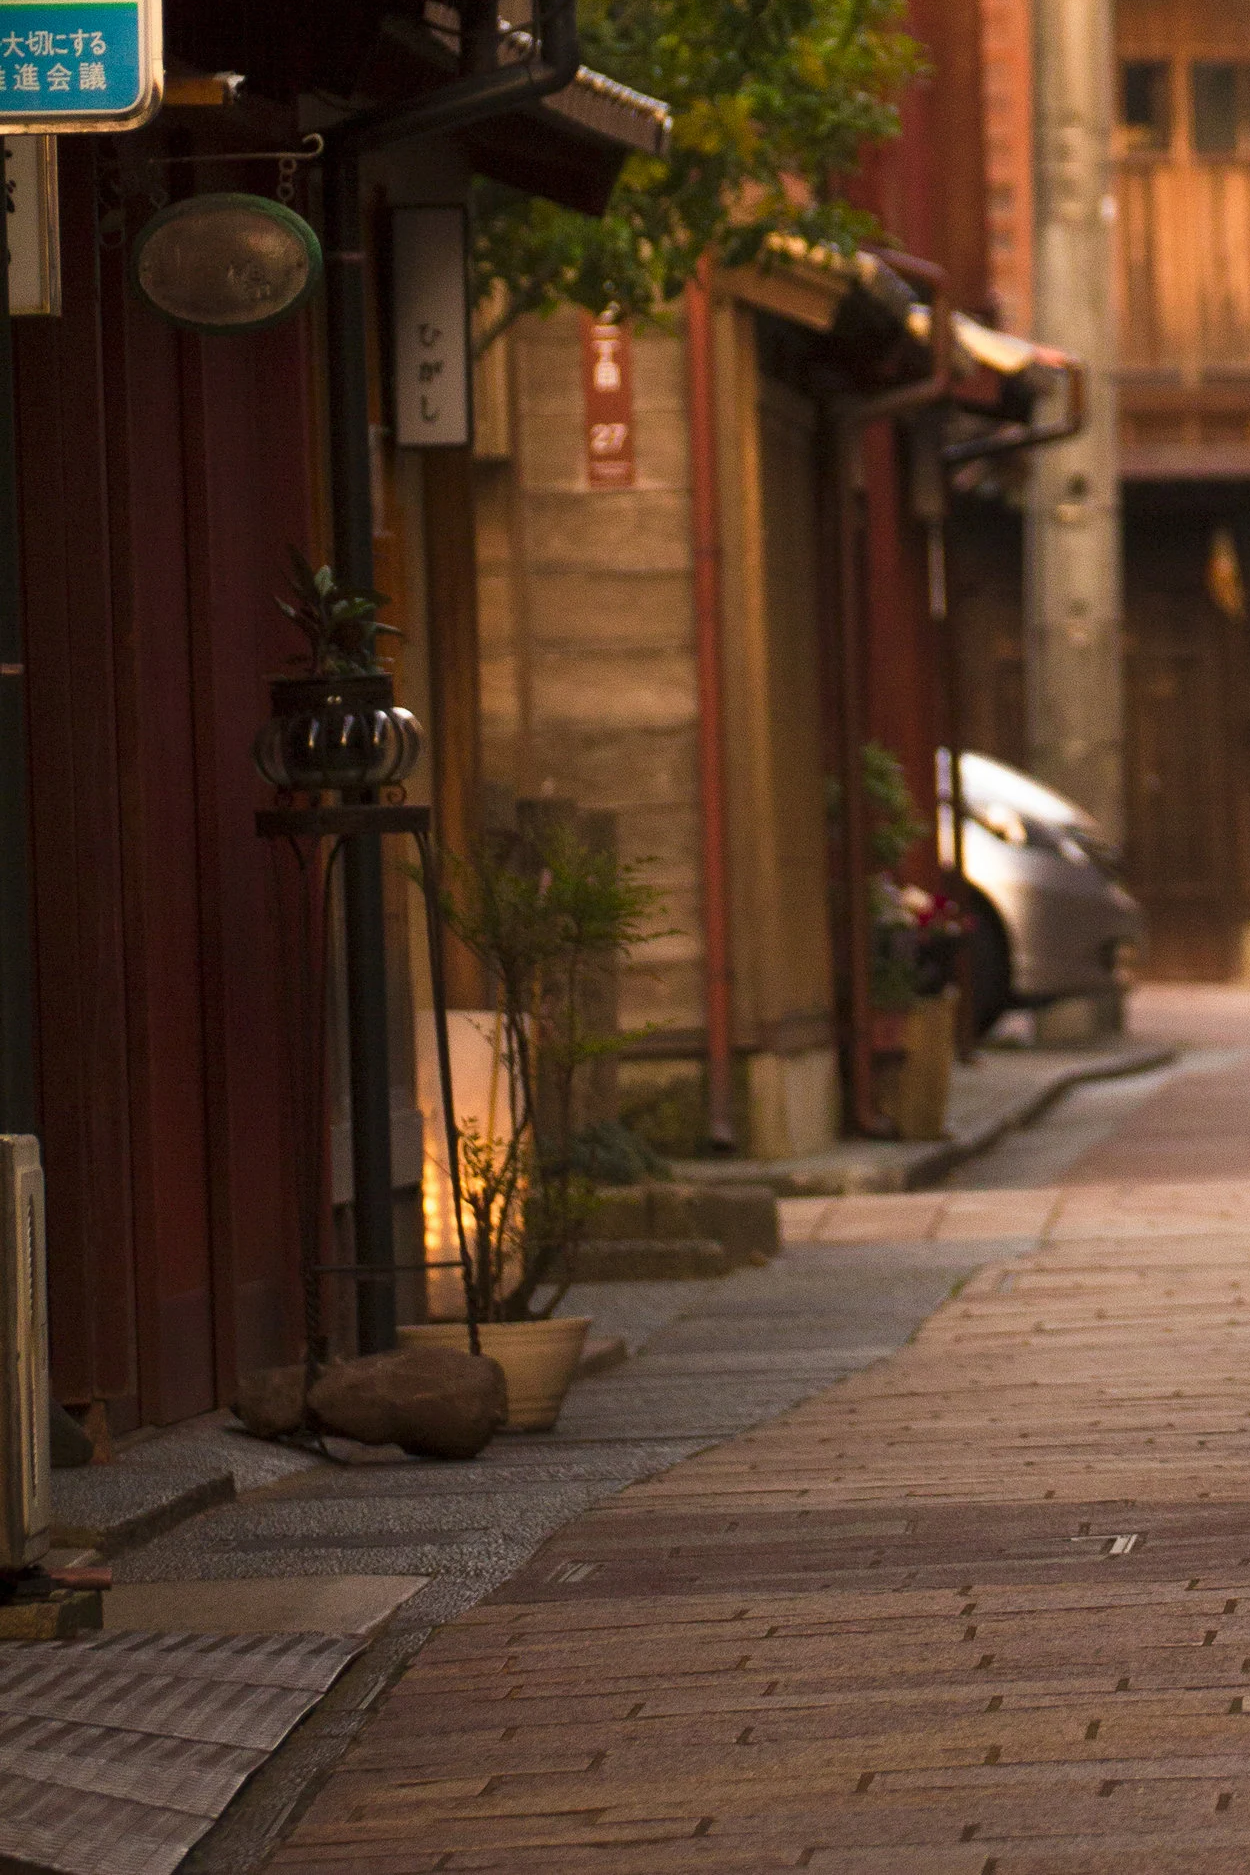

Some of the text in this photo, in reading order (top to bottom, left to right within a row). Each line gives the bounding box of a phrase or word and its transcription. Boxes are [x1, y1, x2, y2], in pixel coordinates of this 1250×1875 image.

[0, 28, 107, 57] 大切にする
[0, 62, 107, 91] 進会議
[590, 423, 628, 455] 27
